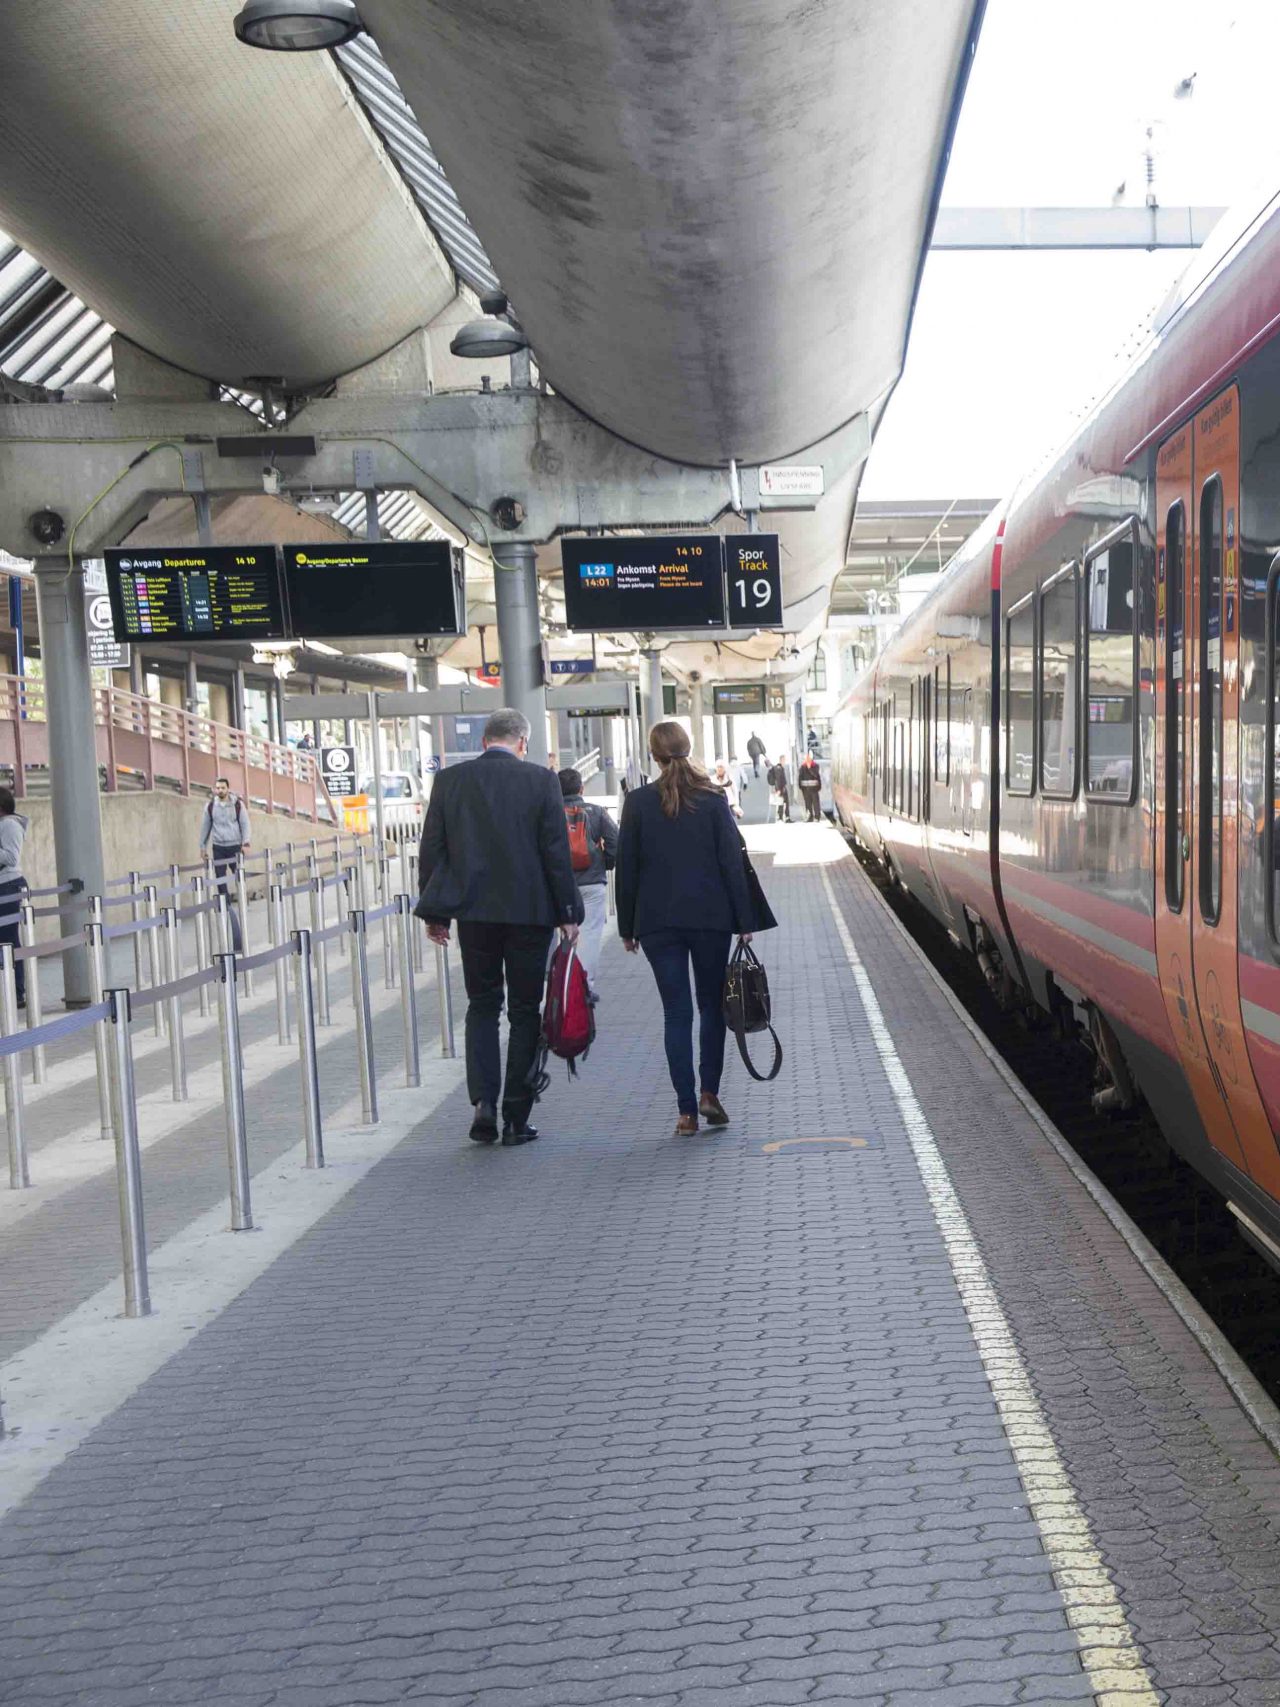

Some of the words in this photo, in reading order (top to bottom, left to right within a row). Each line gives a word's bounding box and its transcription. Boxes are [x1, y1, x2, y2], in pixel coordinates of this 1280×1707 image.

[676, 547, 688, 556] 14
[691, 547, 703, 556] 10
[738, 548, 764, 562] Spor
[133, 560, 162, 569] Avgang
[164, 558, 206, 568] Departures
[235, 557, 245, 565] 14
[246, 557, 256, 565] 10
[739, 559, 769, 571] Track
[616, 565, 657, 575] Ankomst
[659, 564, 689, 573] Arrival
[585, 578, 610, 587] 14:01
[735, 578, 772, 608] 19
[770, 696, 784, 709] 19
